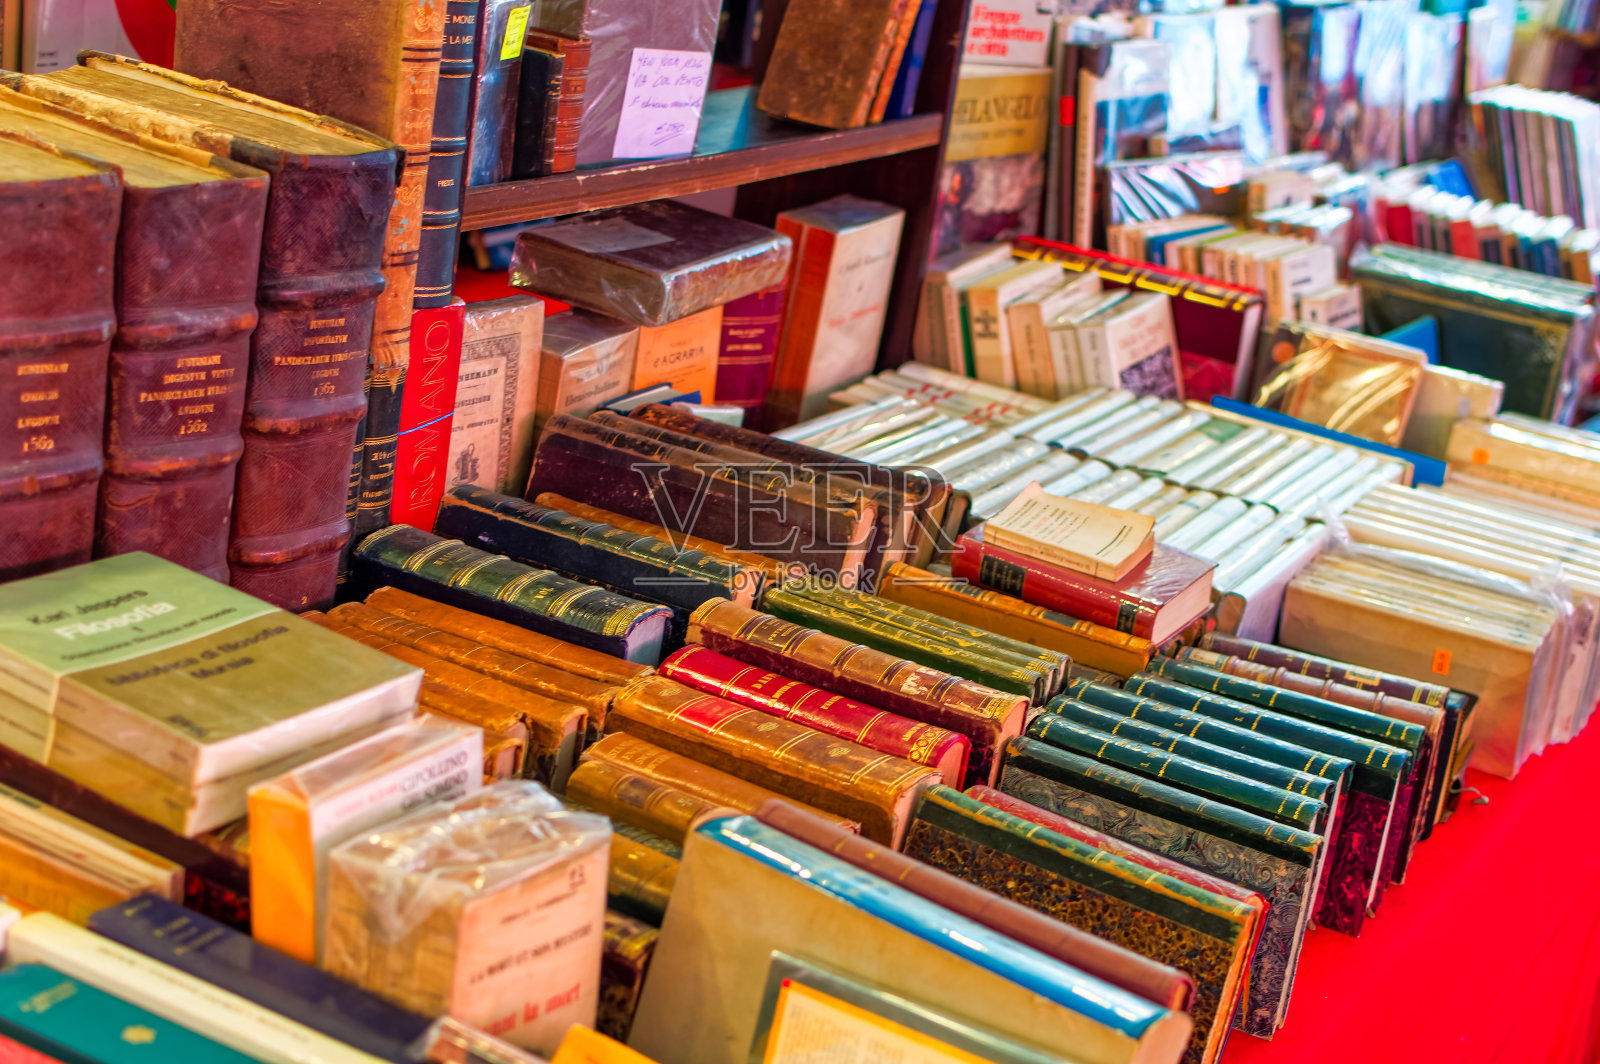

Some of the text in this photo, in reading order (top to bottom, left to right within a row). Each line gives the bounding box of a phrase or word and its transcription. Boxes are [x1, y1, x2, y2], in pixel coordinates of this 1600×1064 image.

[973, 5, 1021, 24] Firenze
[449, 35, 460, 44] LA
[967, 42, 975, 54] e
[409, 320, 450, 510] ROMANO
[27, 609, 71, 625] Karl
[54, 602, 176, 640] Filosofia
[523, 1001, 539, 1025] la
